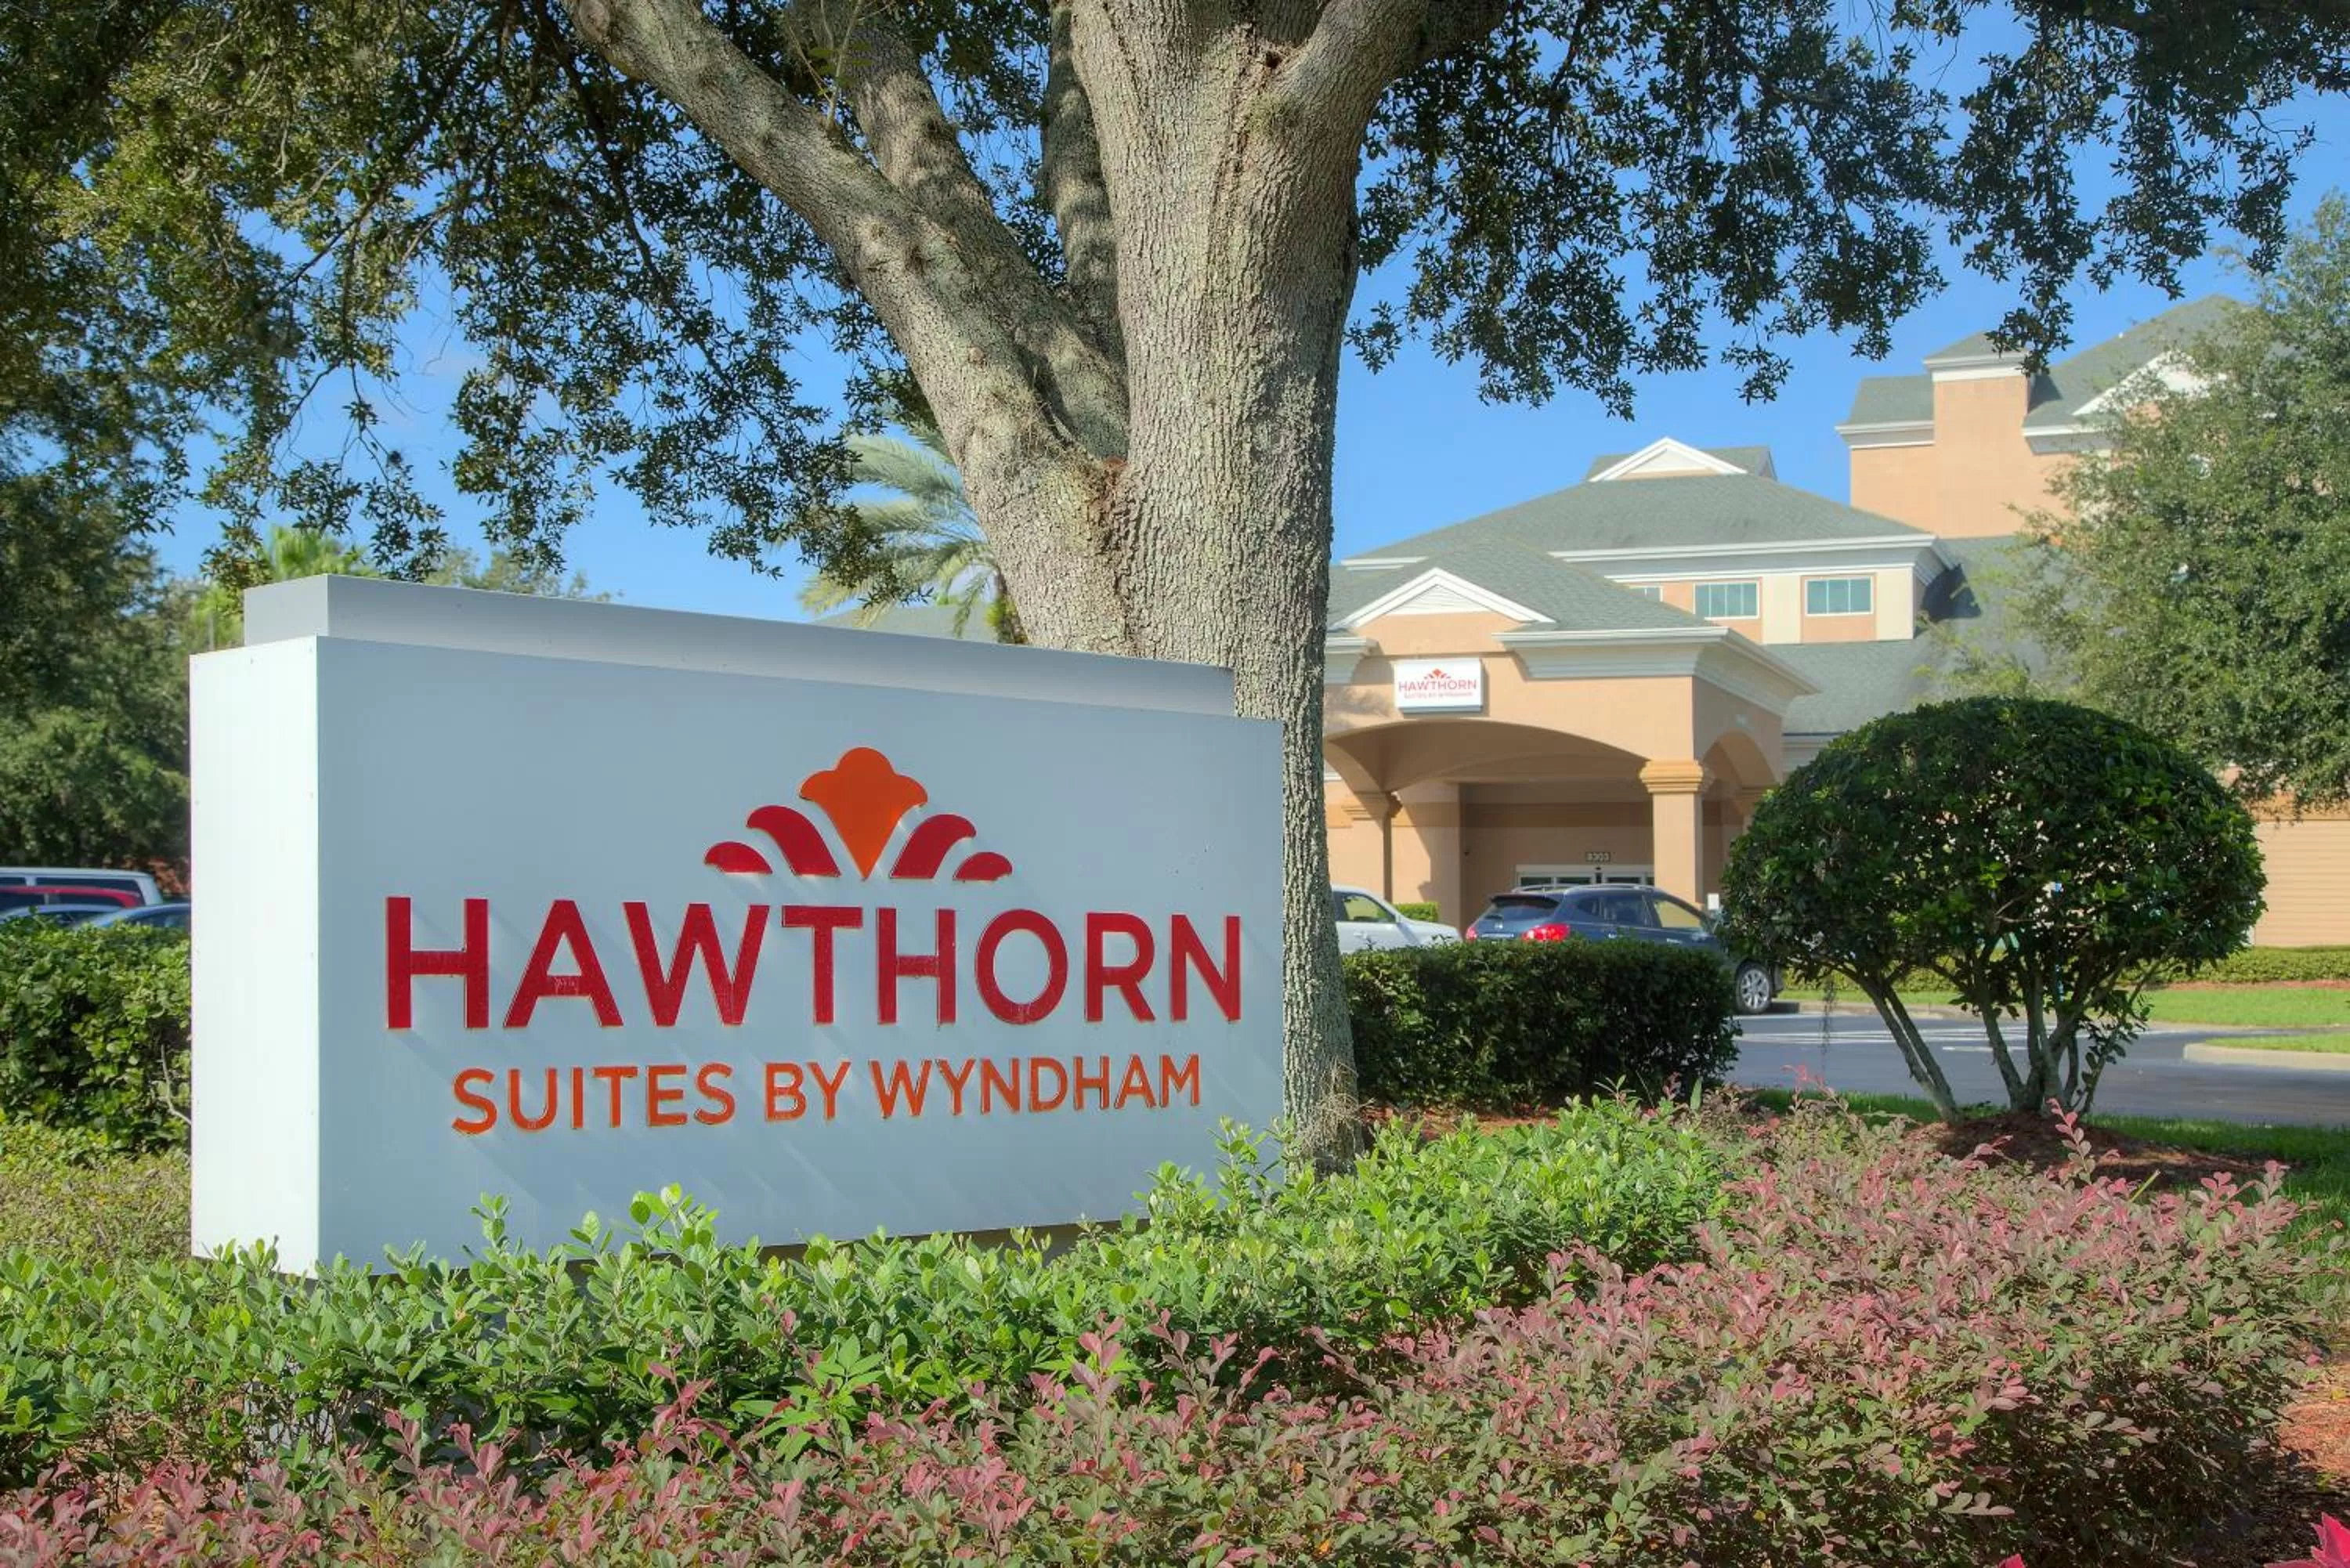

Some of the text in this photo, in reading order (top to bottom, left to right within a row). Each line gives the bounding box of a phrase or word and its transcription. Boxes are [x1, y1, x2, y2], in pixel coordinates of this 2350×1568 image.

[1398, 679, 1477, 691] HAWTHORN
[386, 897, 1242, 1030] HAWTHORN
[452, 1053, 1200, 1135] SUITES BY WYNDHAM
